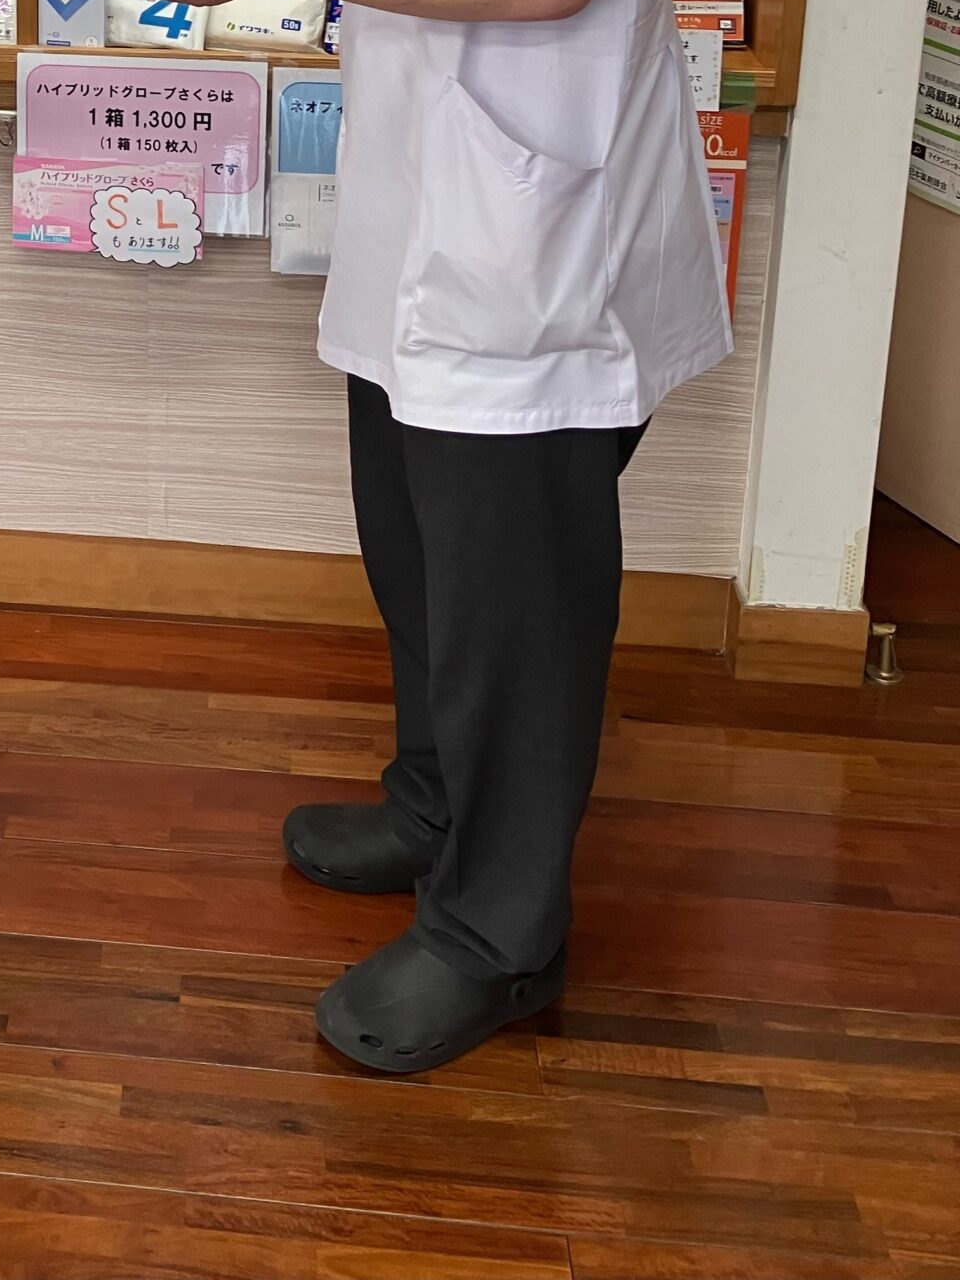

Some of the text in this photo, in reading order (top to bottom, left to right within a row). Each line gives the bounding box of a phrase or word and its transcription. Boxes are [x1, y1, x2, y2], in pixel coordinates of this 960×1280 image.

[139, 1, 193, 39] 4
[37, 83, 234, 103] ハイブリッドグローブさくらは
[211, 163, 239, 175] です
[106, 194, 129, 229] S
[156, 199, 178, 229] L
[30, 224, 44, 241] M
